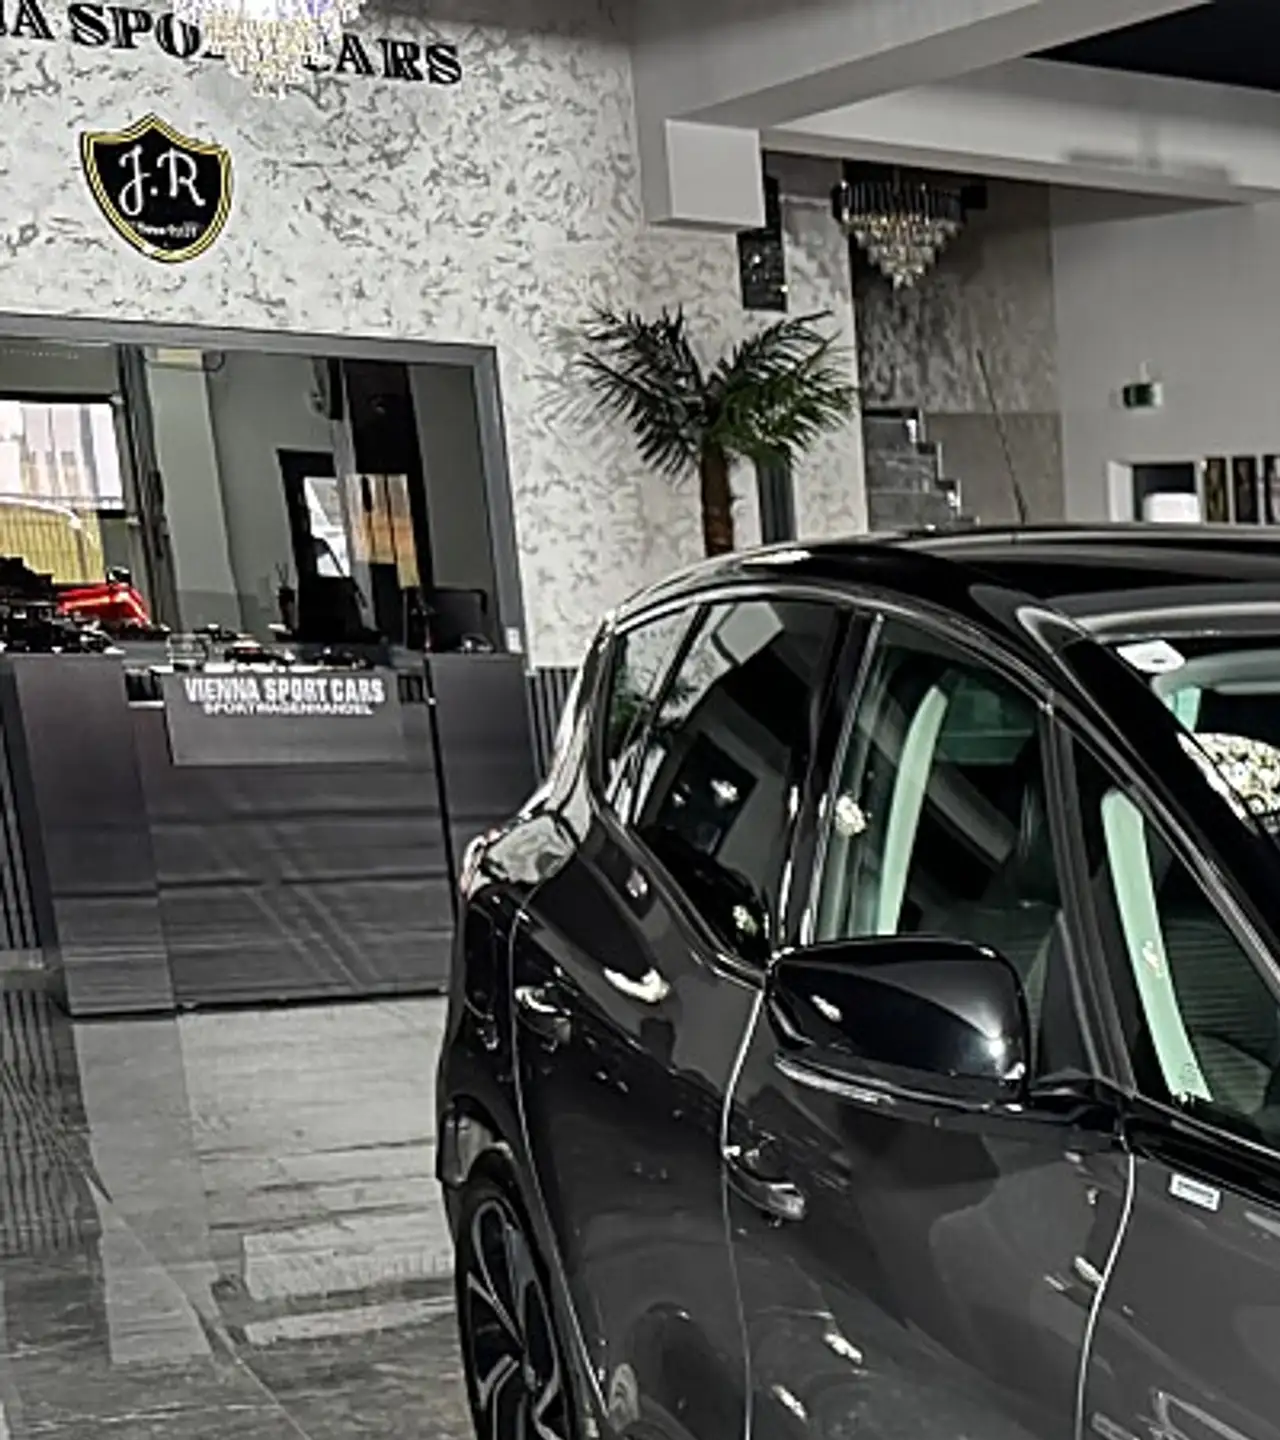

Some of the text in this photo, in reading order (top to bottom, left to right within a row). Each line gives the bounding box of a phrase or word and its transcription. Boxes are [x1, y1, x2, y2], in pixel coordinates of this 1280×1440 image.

[183, 677, 385, 703] VIENNA SPORT CARS
